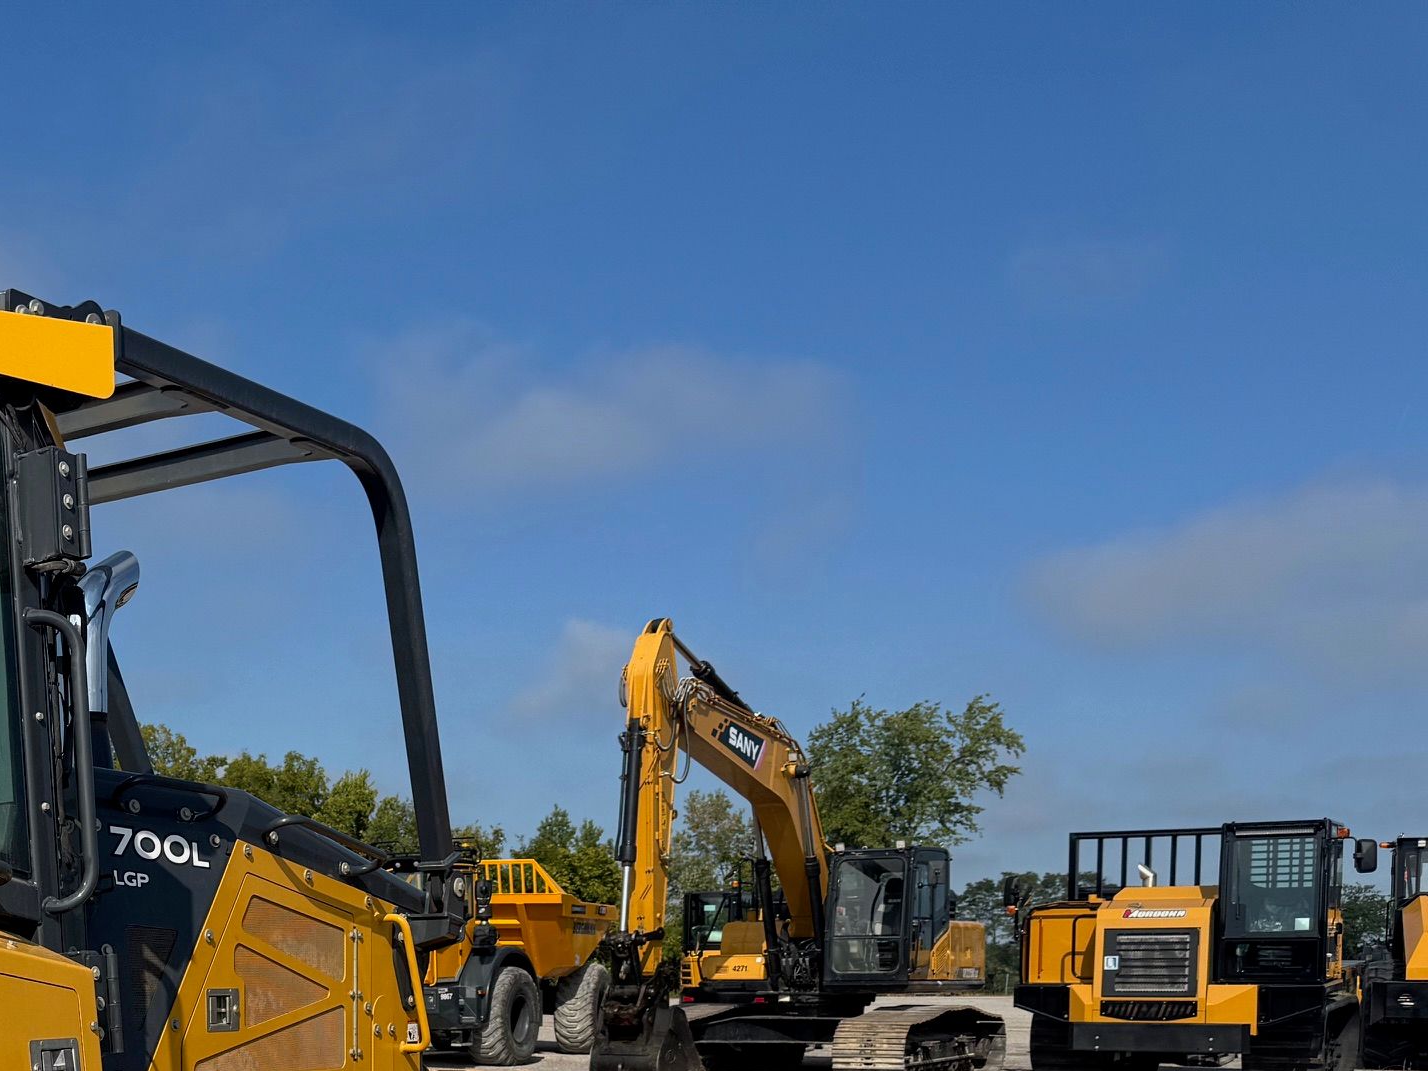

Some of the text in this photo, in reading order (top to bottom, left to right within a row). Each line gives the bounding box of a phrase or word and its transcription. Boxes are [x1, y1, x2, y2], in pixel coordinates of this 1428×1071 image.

[728, 726, 759, 760] SANY
[109, 825, 210, 868] 700L
[113, 869, 150, 888] LGP
